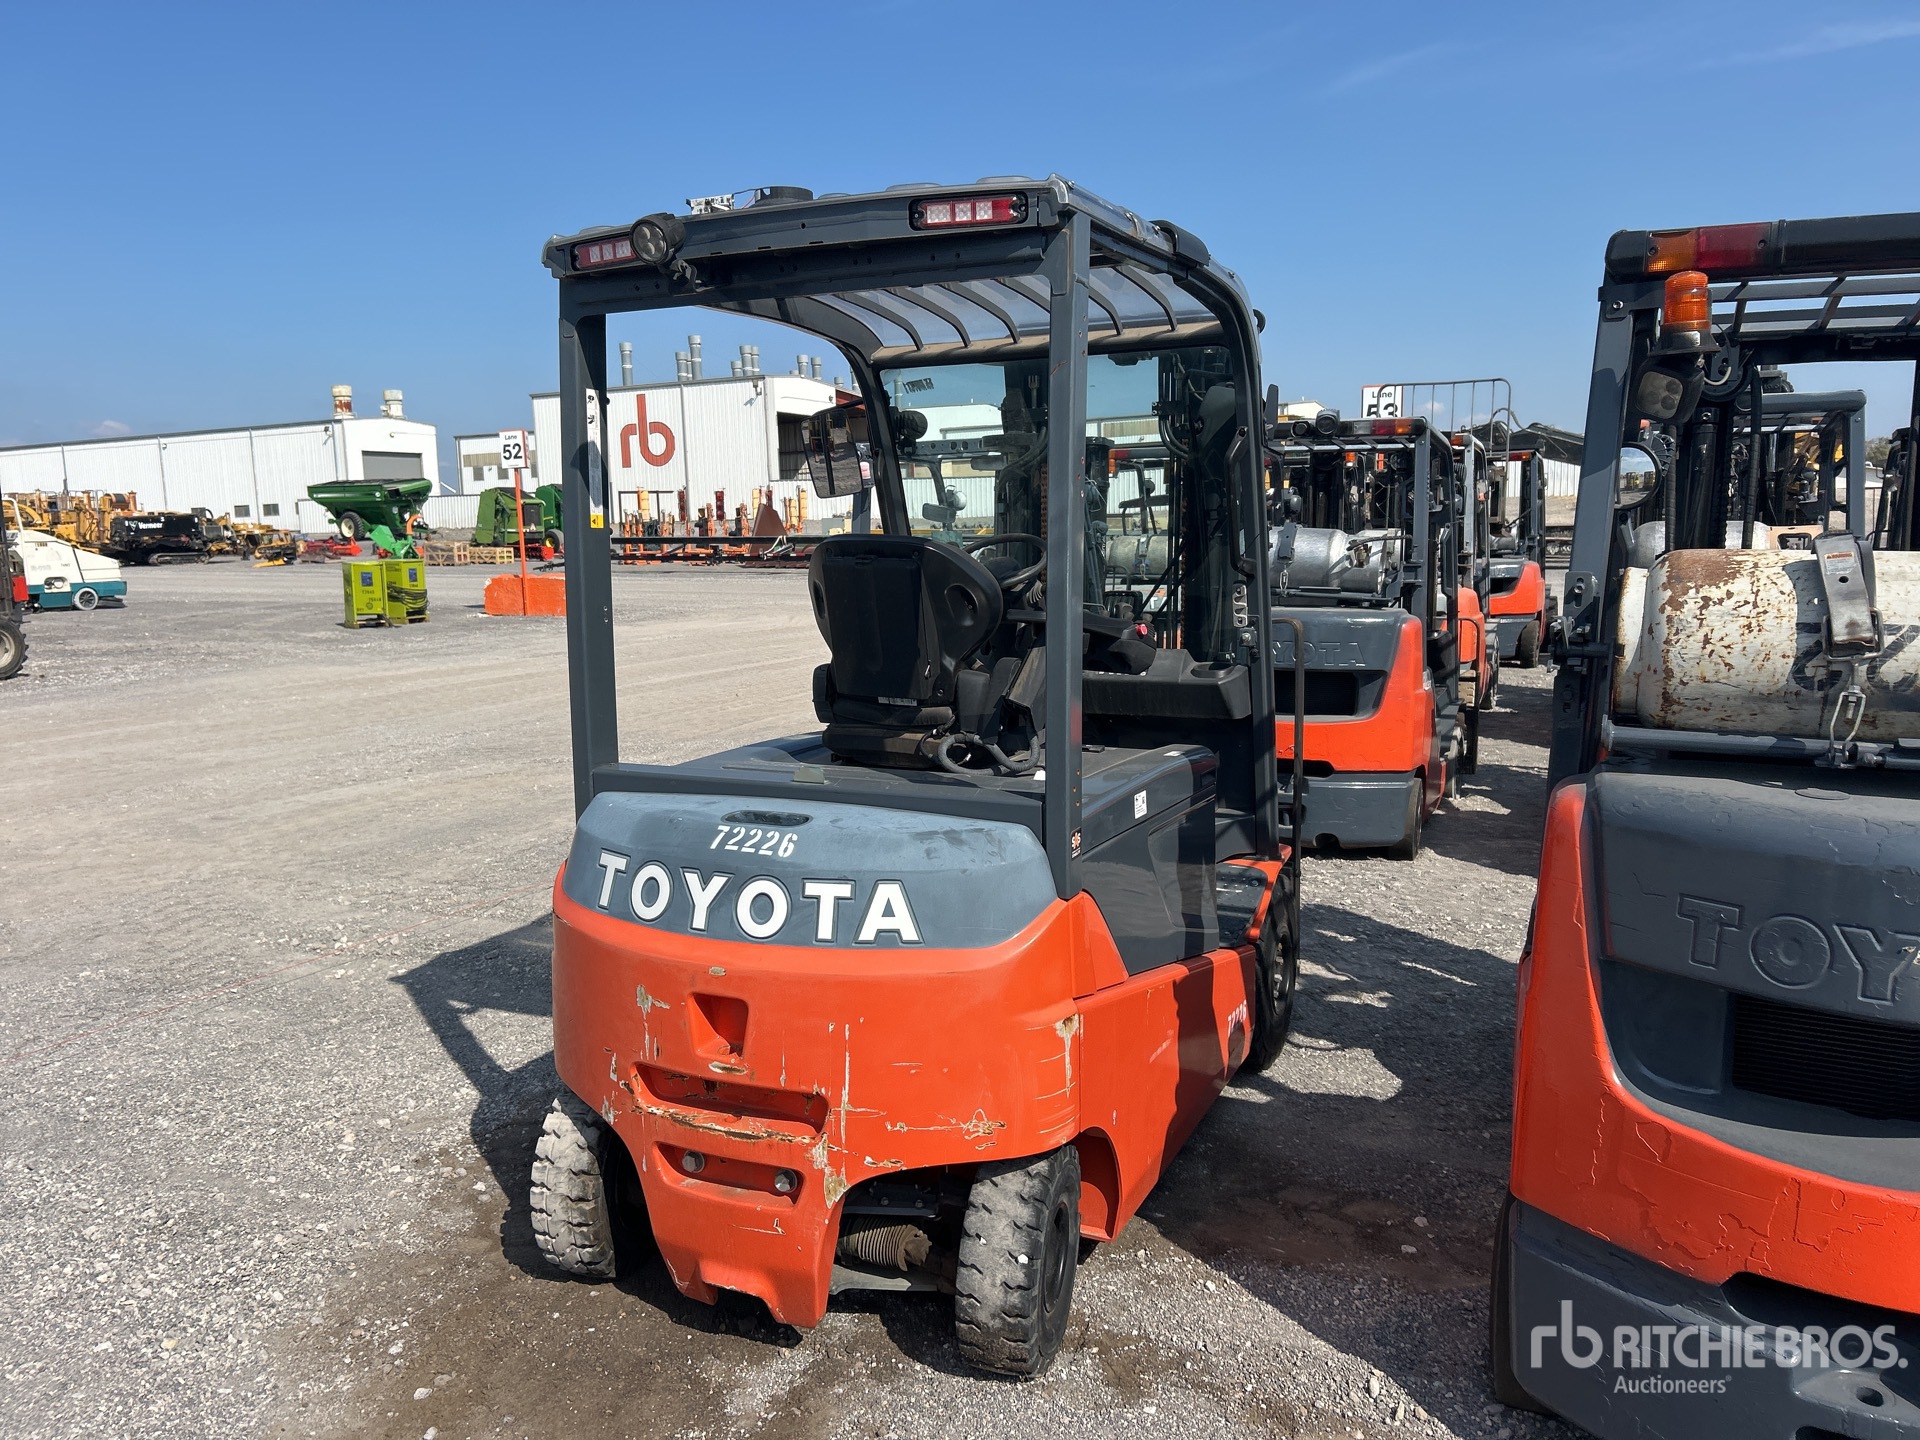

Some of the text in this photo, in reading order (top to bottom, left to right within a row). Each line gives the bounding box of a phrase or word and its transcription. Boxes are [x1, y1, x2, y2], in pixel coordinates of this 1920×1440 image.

[502, 442, 523, 461] 52
[138, 521, 163, 530] Vermeer
[709, 825, 799, 858] 72226
[597, 848, 923, 944] TOYOTA
[1676, 893, 1920, 1006] TOY
